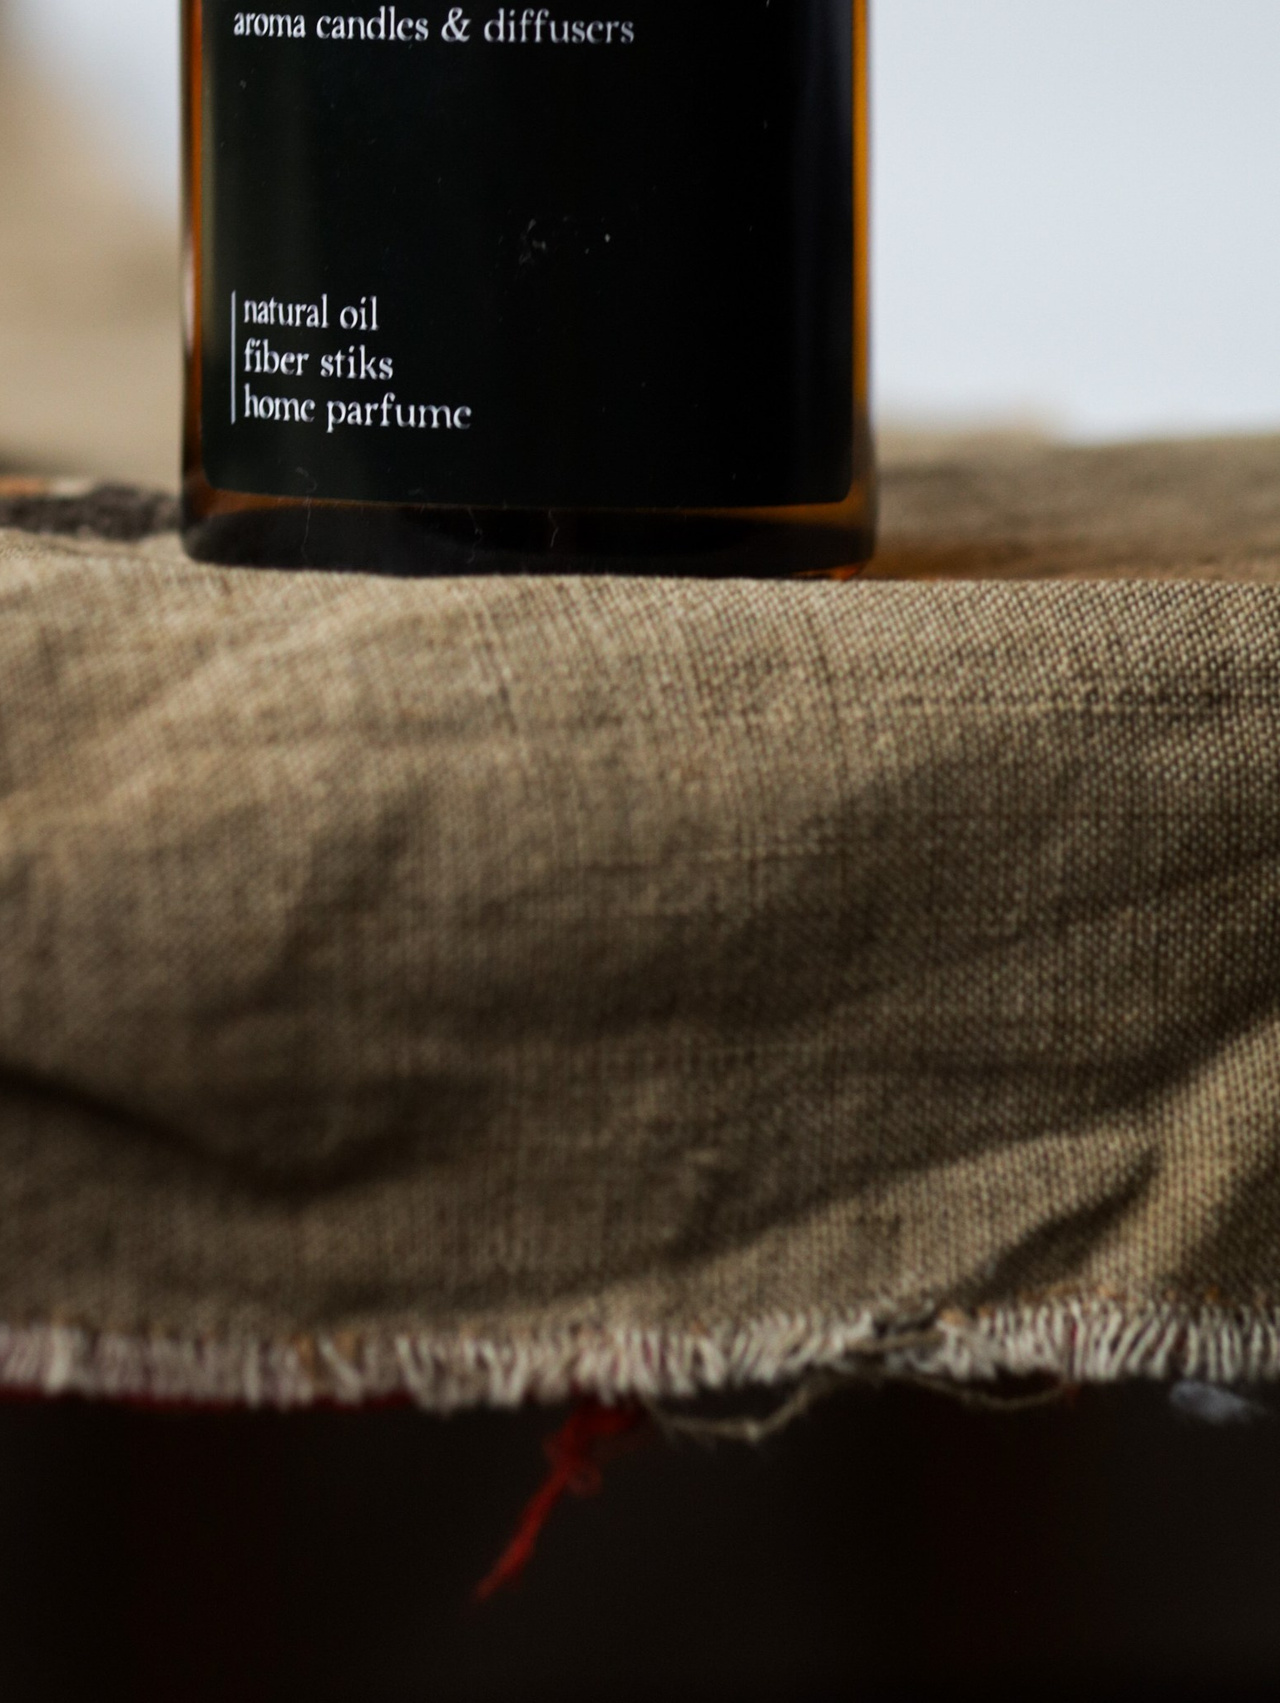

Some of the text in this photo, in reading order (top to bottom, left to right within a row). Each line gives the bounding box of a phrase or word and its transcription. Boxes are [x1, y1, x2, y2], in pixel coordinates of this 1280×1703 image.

[233, 5, 635, 43] aroma candles & diffusers
[243, 293, 379, 331] natural oil
[243, 337, 394, 380] fiber stiks
[243, 382, 472, 434] home parfume
